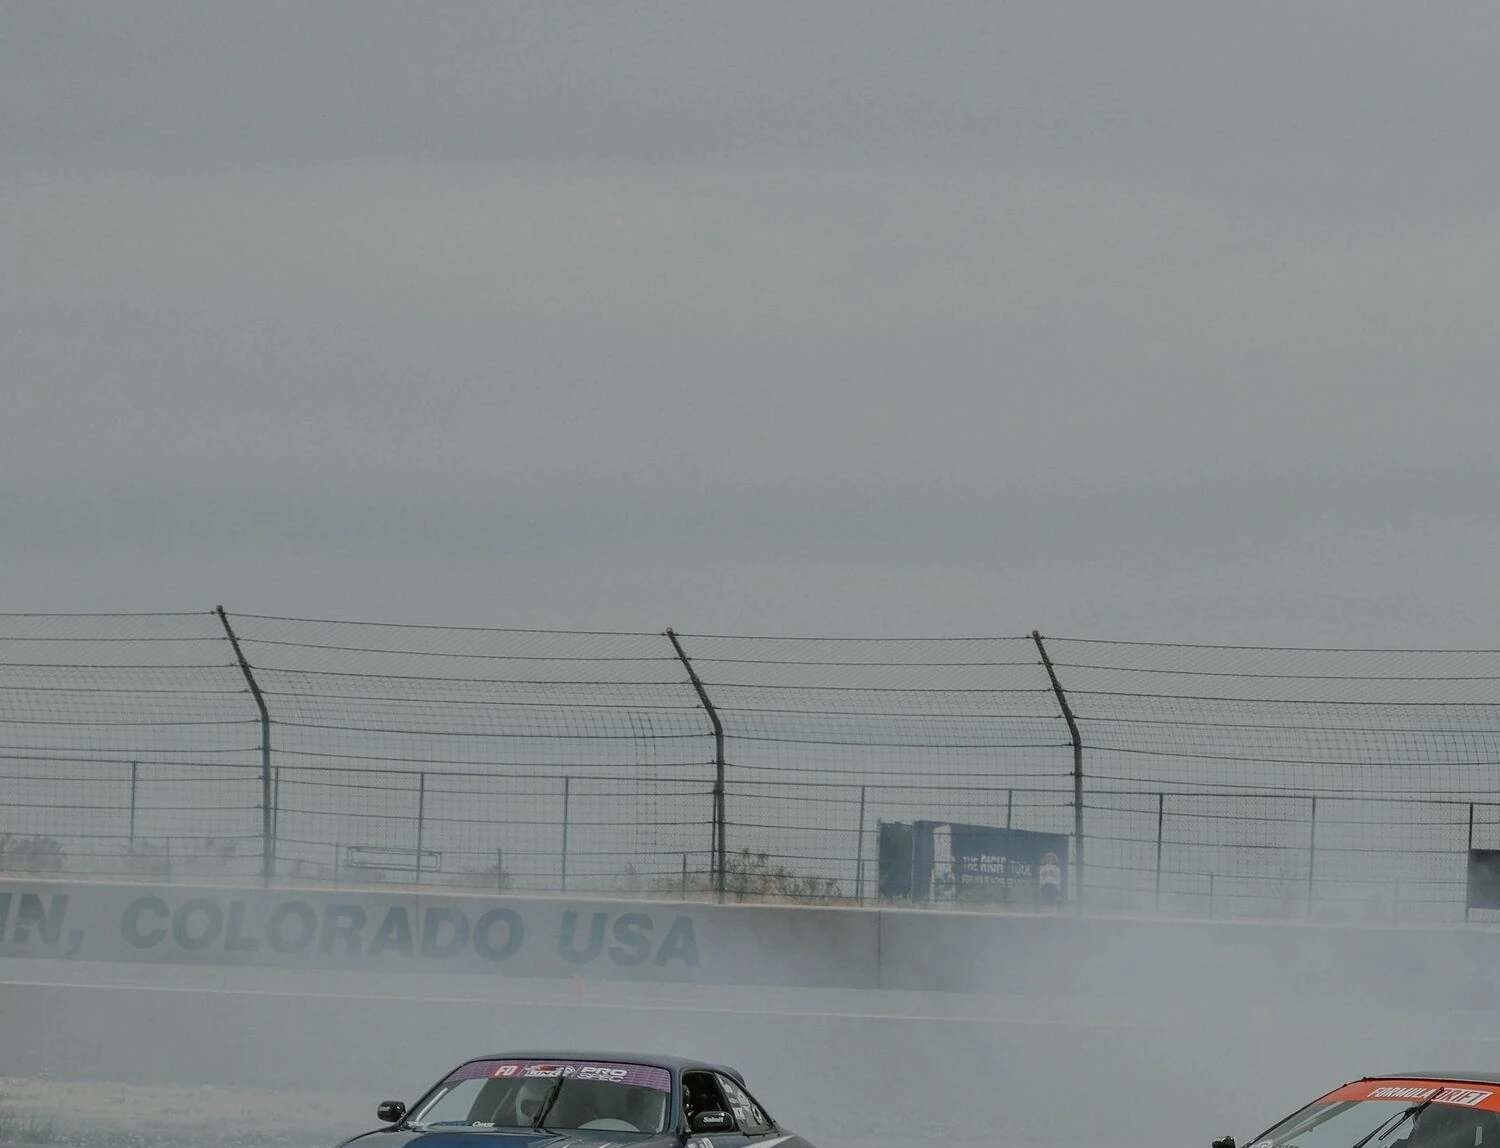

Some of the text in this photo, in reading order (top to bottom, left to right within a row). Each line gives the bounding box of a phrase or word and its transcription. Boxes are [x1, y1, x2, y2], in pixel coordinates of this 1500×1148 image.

[121, 896, 525, 962] COLORADO
[558, 910, 700, 968] USA
[577, 1073, 623, 1082] SPEC
[581, 1067, 627, 1077] PRO
[1366, 1087, 1491, 1105] FORMULA DRIFT
